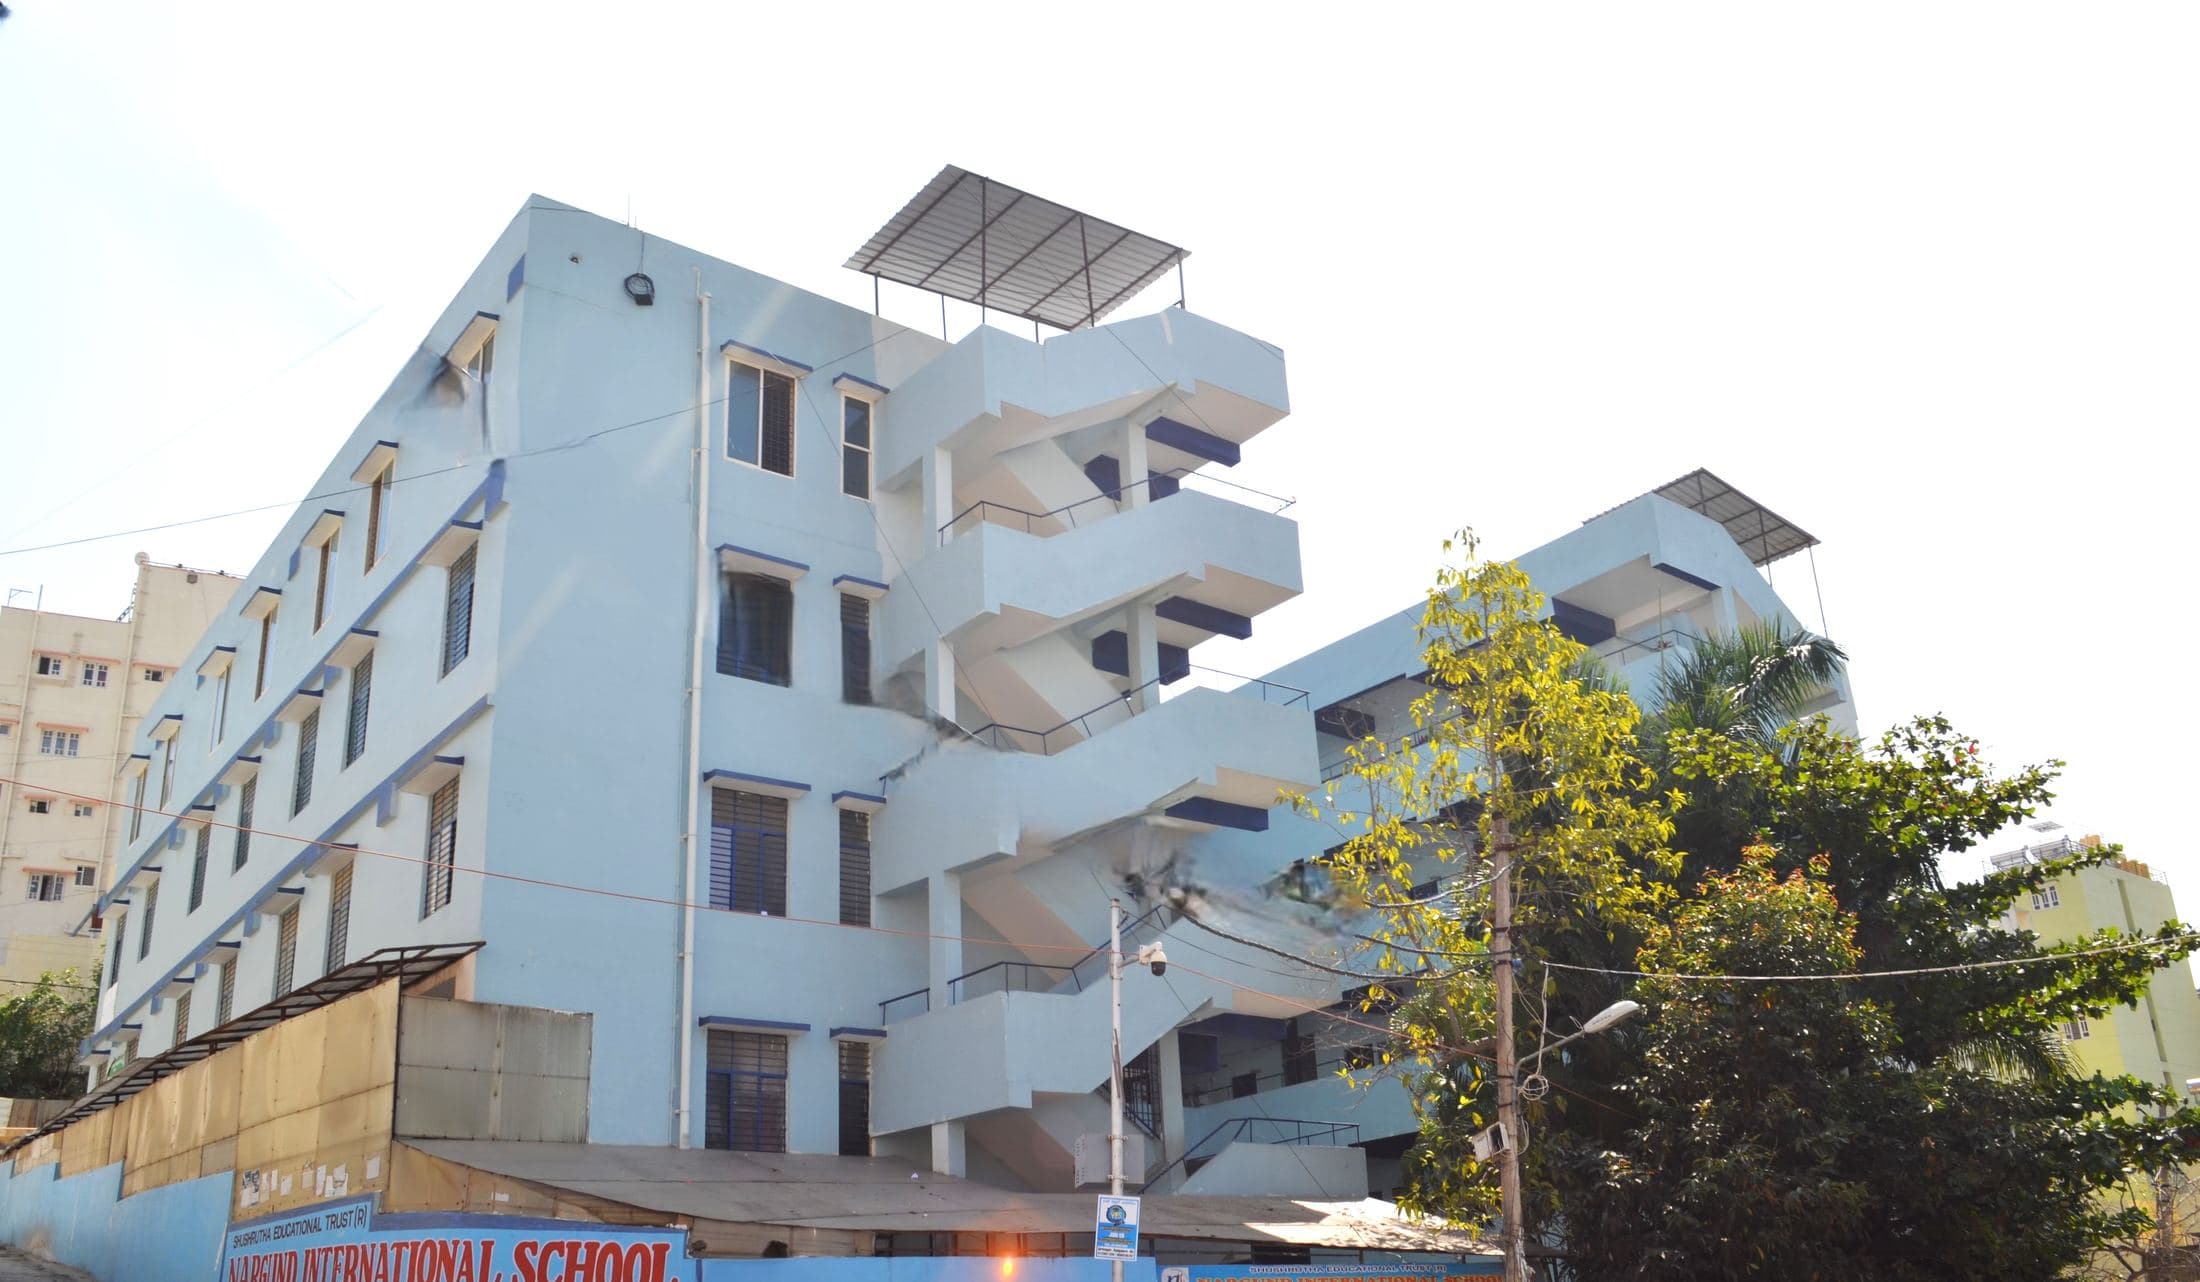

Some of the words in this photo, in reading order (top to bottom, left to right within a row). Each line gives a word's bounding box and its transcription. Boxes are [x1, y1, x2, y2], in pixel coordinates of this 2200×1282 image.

[273, 1216, 322, 1240] EDUCATIONAL
[302, 1239, 502, 1282] INTERNATIONAL
[512, 1240, 679, 1282] SCHOOL
